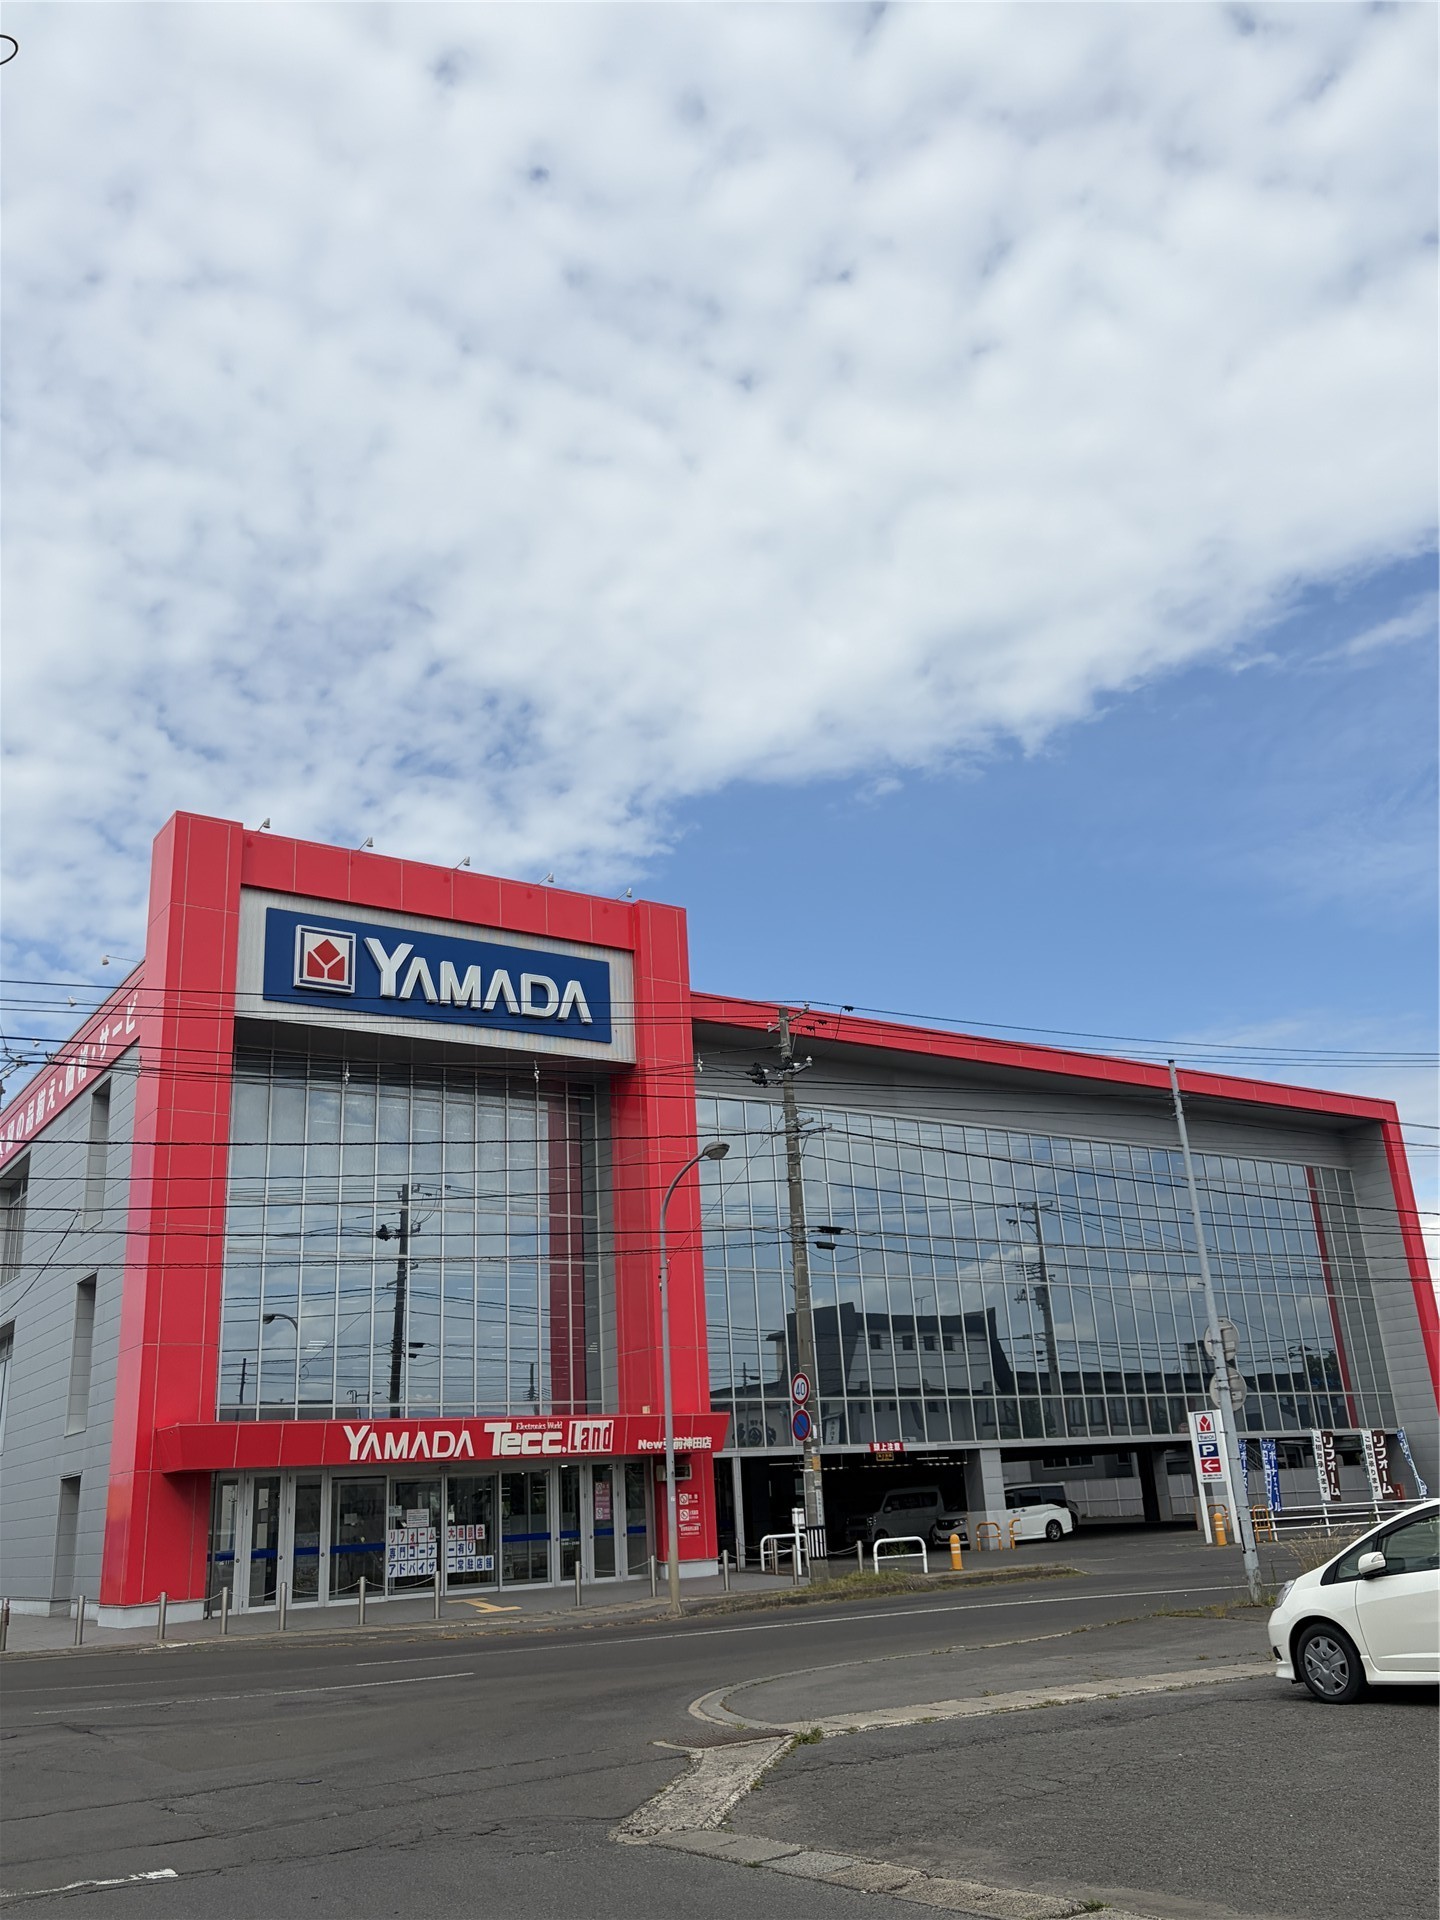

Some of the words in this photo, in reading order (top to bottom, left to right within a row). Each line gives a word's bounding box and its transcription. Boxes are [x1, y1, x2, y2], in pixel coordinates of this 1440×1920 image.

[364, 937, 593, 1025] YAMADA
[795, 1382, 806, 1396] 40
[516, 1422, 546, 1430] Electronics
[547, 1421, 563, 1430] World
[343, 1425, 475, 1461] YAMADA
[1202, 1445, 1215, 1456] P
[1323, 1436, 1340, 1496] リフォーム
[1373, 1435, 1394, 1494] リフォーム
[389, 1561, 435, 1576] アドバイザ
